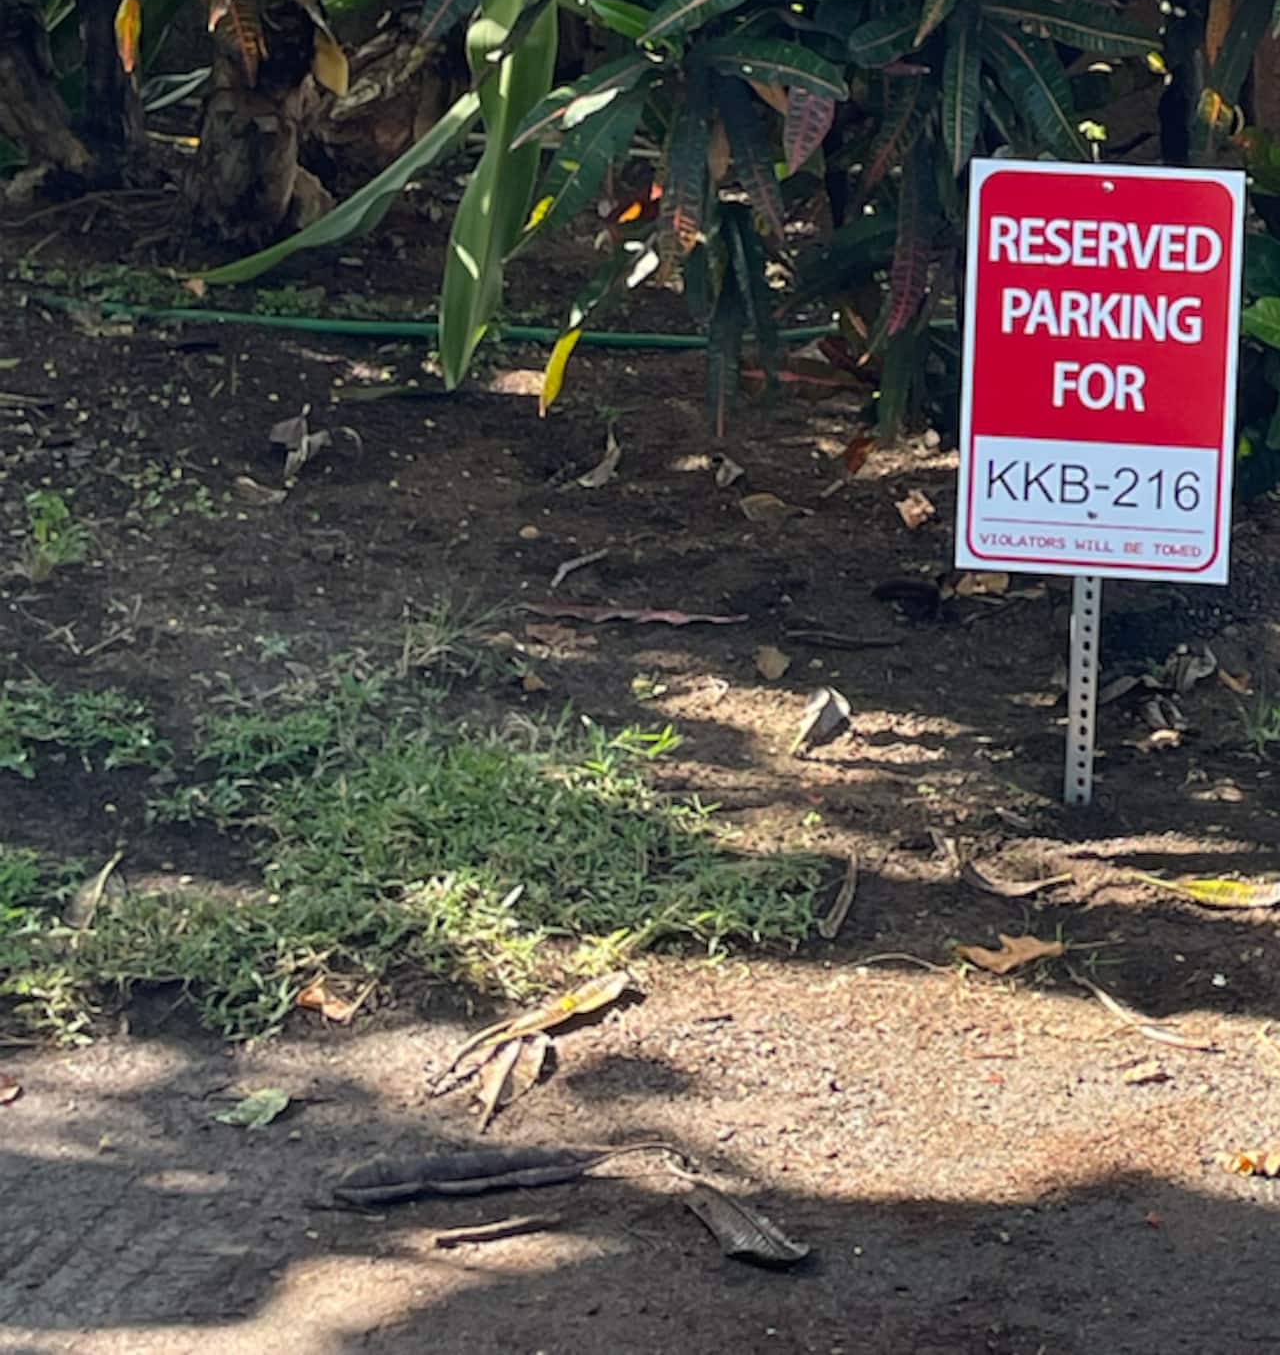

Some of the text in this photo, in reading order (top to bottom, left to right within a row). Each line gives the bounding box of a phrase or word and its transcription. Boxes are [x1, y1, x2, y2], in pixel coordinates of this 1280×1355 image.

[988, 216, 1222, 273] RESERVED
[1001, 287, 1202, 343] PARKING
[1052, 361, 1146, 412] FOR
[986, 459, 1200, 511] KKB-216
[979, 533, 1203, 557] VIOLATORS WILL BE TOWED
